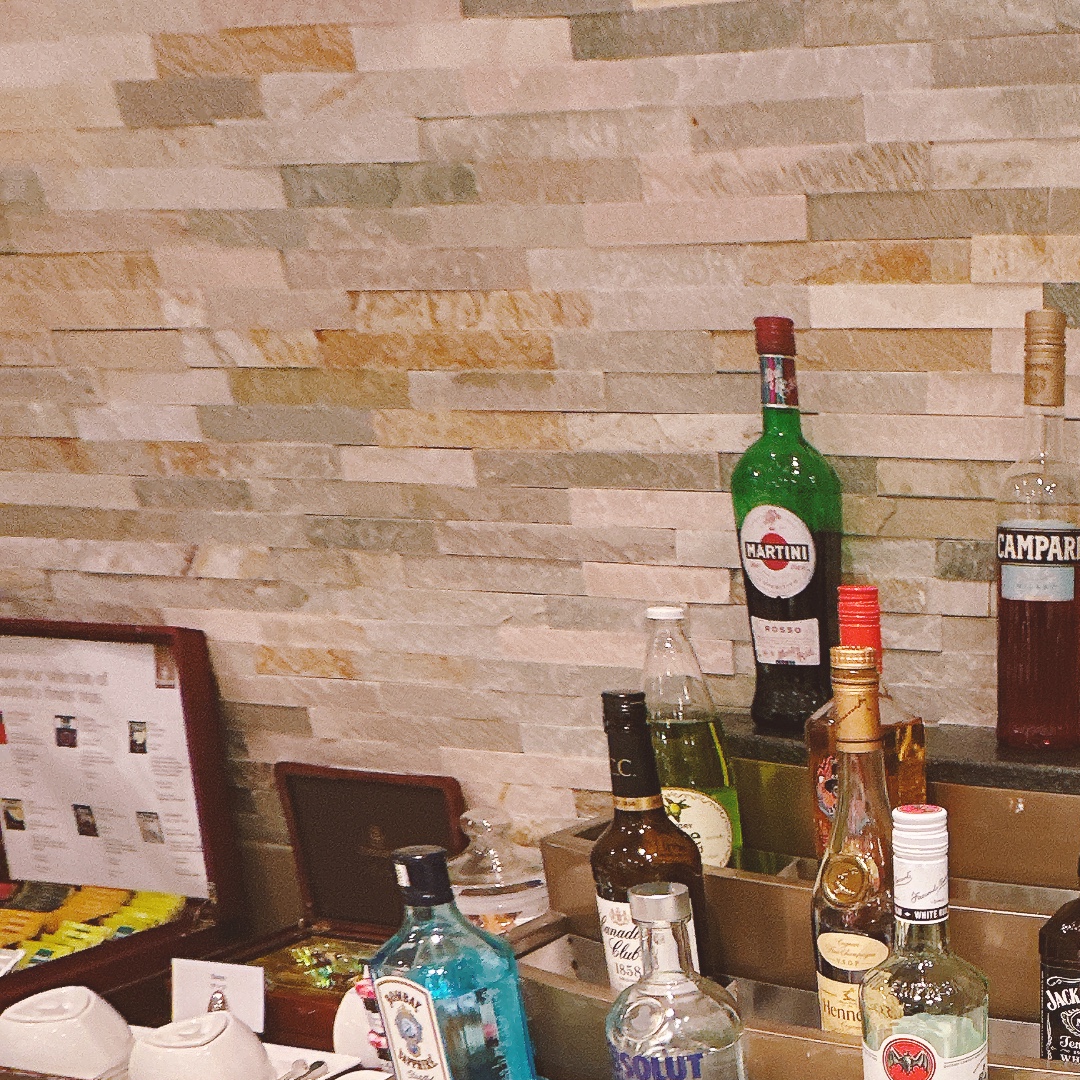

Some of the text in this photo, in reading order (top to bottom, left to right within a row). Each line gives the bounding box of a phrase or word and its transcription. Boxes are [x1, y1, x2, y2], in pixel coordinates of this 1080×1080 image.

[746, 543, 809, 562] MARTINI
[765, 626, 802, 635] ROSSO
[913, 909, 938, 921] WHITE
[609, 938, 641, 960] Club
[614, 962, 641, 977] 1858
[1046, 987, 1080, 1011] JACK
